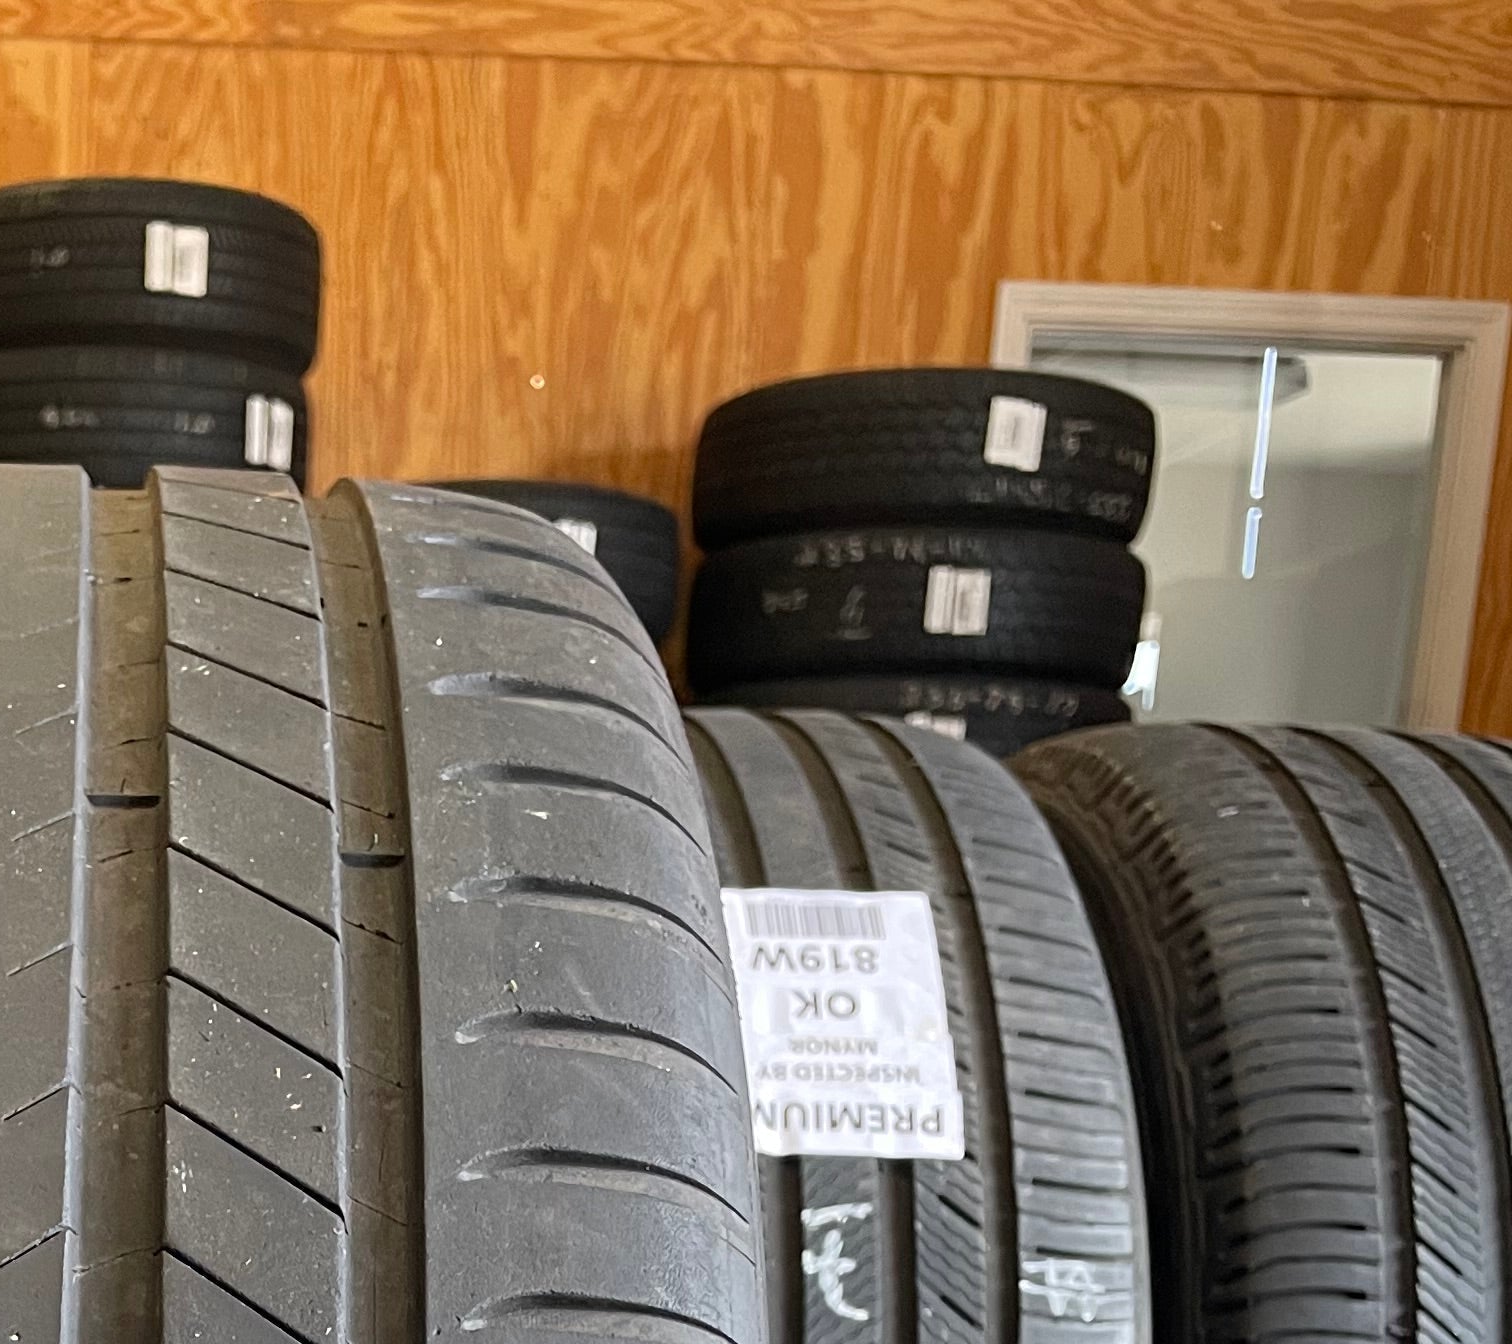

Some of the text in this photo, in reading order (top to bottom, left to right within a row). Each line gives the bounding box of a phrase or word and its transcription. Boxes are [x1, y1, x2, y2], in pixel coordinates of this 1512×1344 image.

[752, 944, 880, 975] 819W
[792, 988, 859, 1020] OK
[791, 1036, 879, 1055] MYNOR
[758, 1062, 922, 1084] INSPECTED BY
